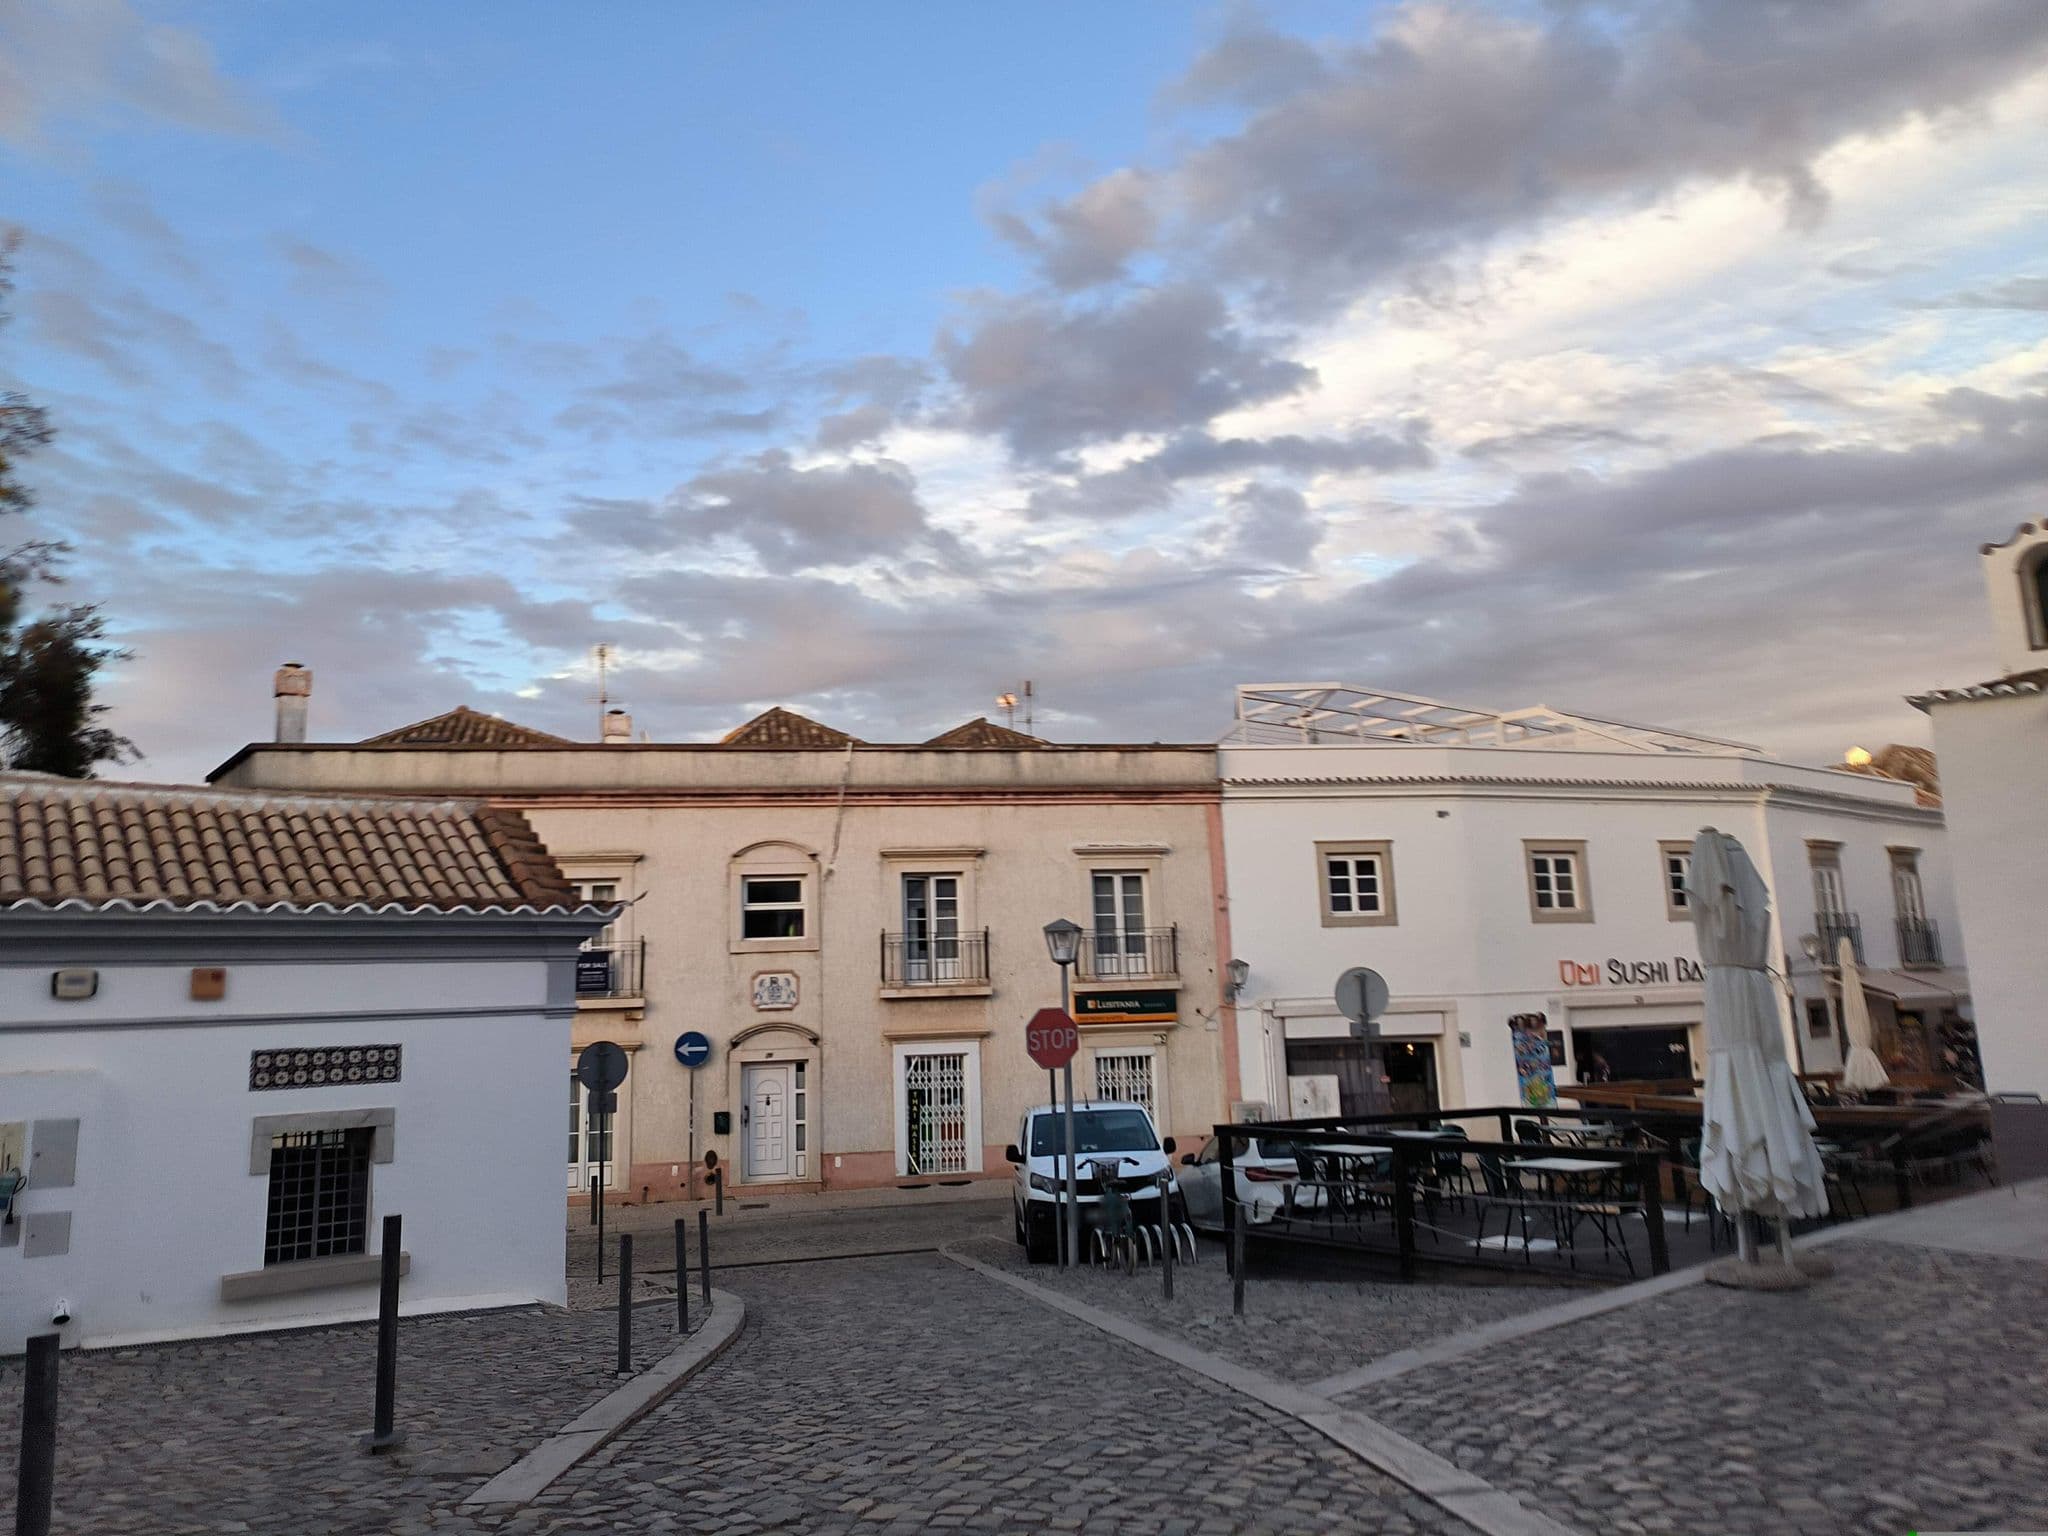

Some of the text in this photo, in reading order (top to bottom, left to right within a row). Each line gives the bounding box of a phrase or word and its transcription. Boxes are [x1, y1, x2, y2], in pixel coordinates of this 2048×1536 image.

[1606, 957, 1669, 985] SUSHI
[1674, 956, 1705, 983] BA
[1097, 999, 1141, 1009] LUSITANIA
[1029, 1028, 1077, 1051] STOP
[911, 1091, 919, 1119] THAI
